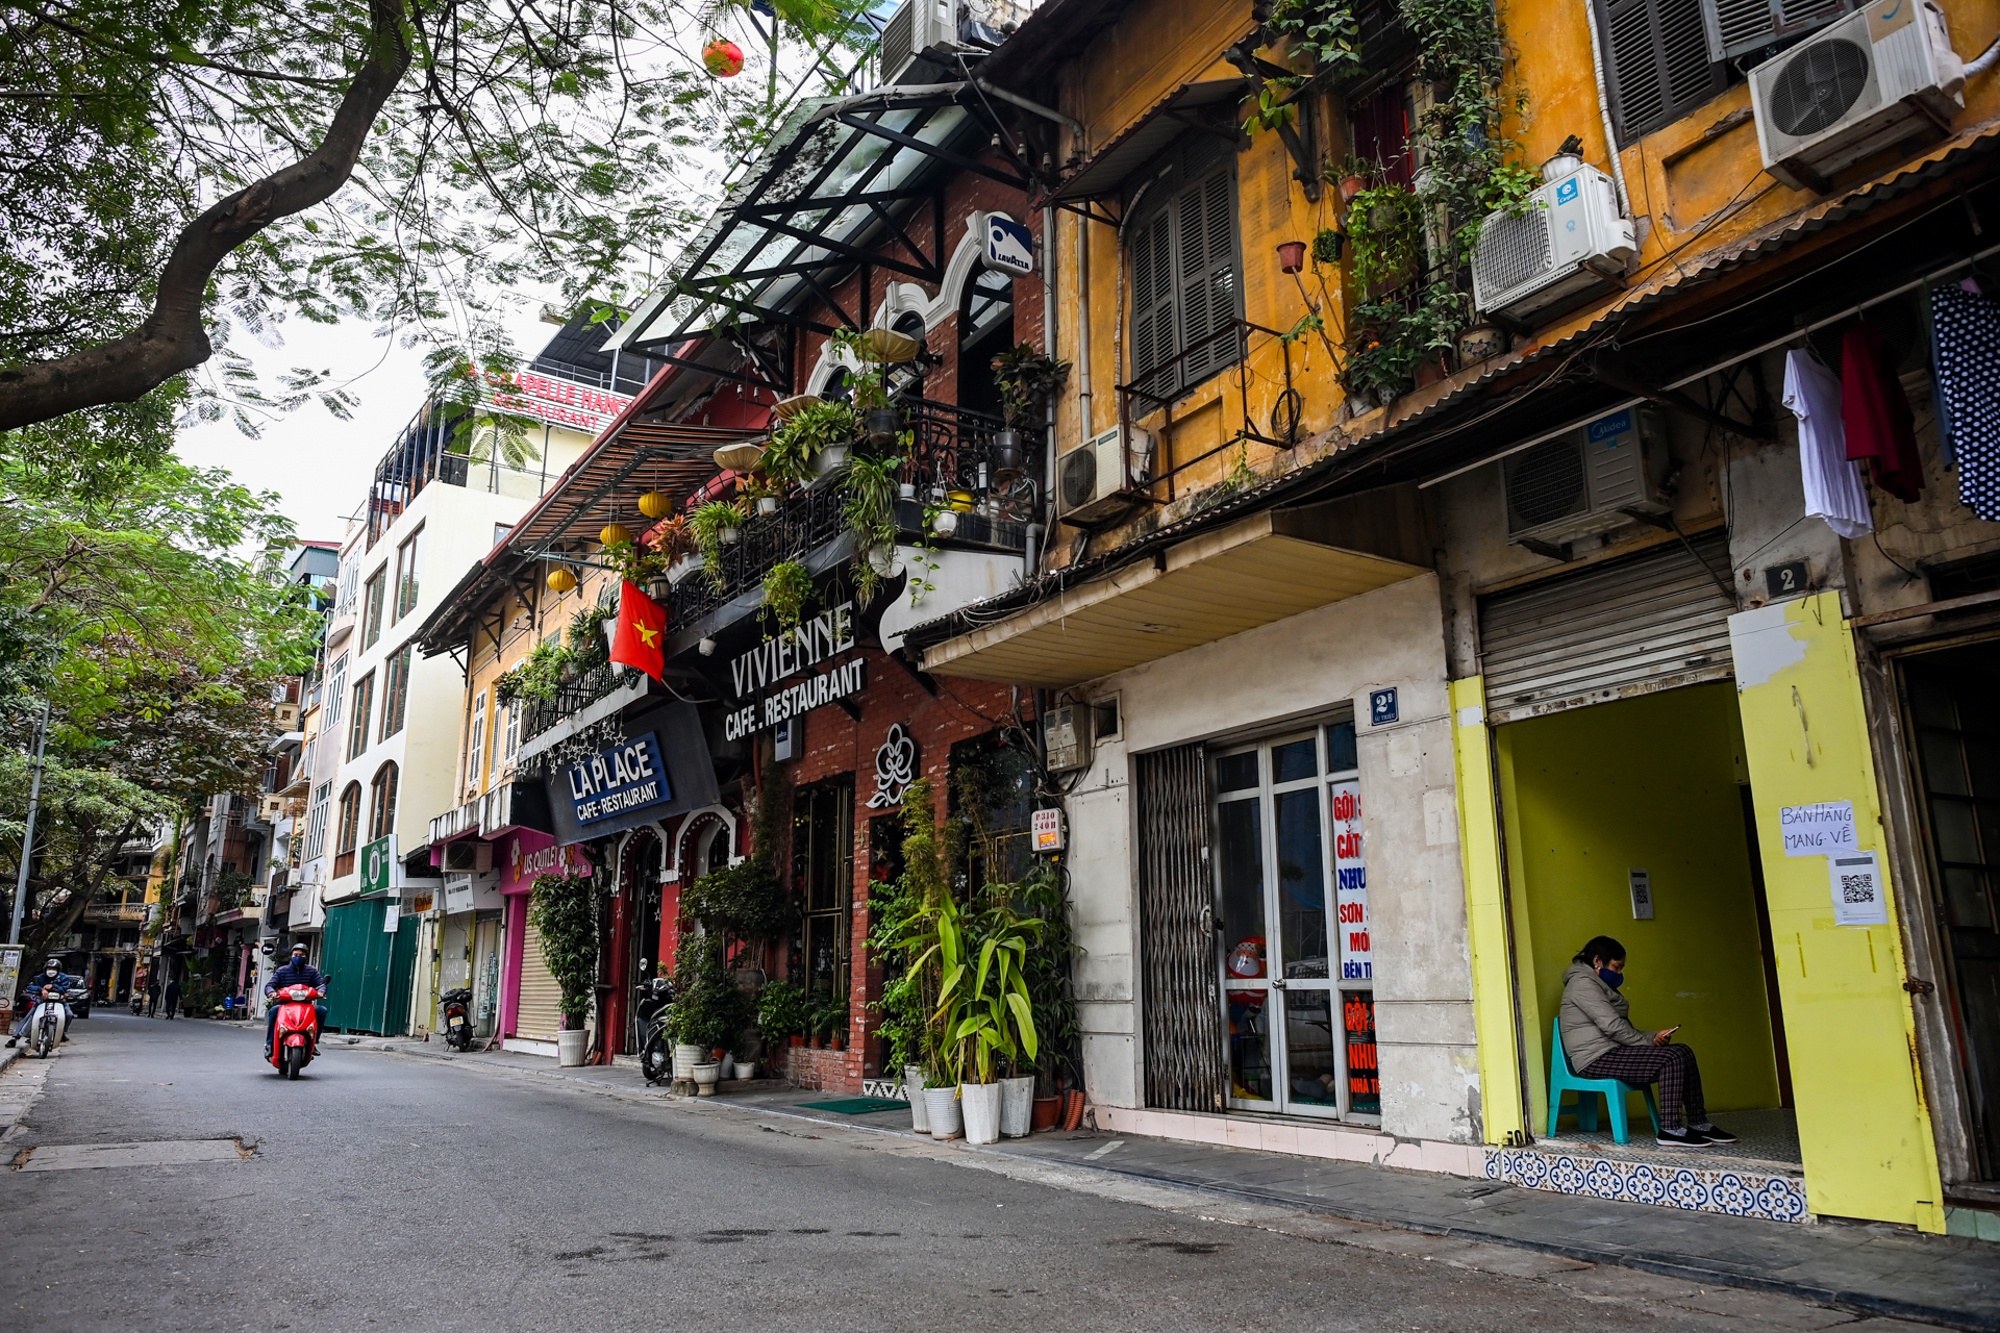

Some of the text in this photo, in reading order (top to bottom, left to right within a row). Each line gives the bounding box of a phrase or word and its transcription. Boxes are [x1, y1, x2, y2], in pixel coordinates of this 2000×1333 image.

[997, 253, 1030, 271] LAVAZZA
[1591, 420, 1627, 439] Midea
[1780, 569, 1795, 590] 2
[730, 600, 855, 698] VIVIENNE
[725, 704, 756, 742] CAFE
[765, 657, 864, 727] RESTAURANT
[569, 741, 653, 800] LA PLACE
[1334, 790, 1355, 824] GỘI
[1337, 824, 1360, 859] CẮT
[1830, 823, 1852, 843] VỀ
[524, 853, 533, 875] US
[534, 845, 558, 872] OUTLET
[1344, 959, 1361, 979] BÊN
[1345, 996, 1368, 1035] GỘI
